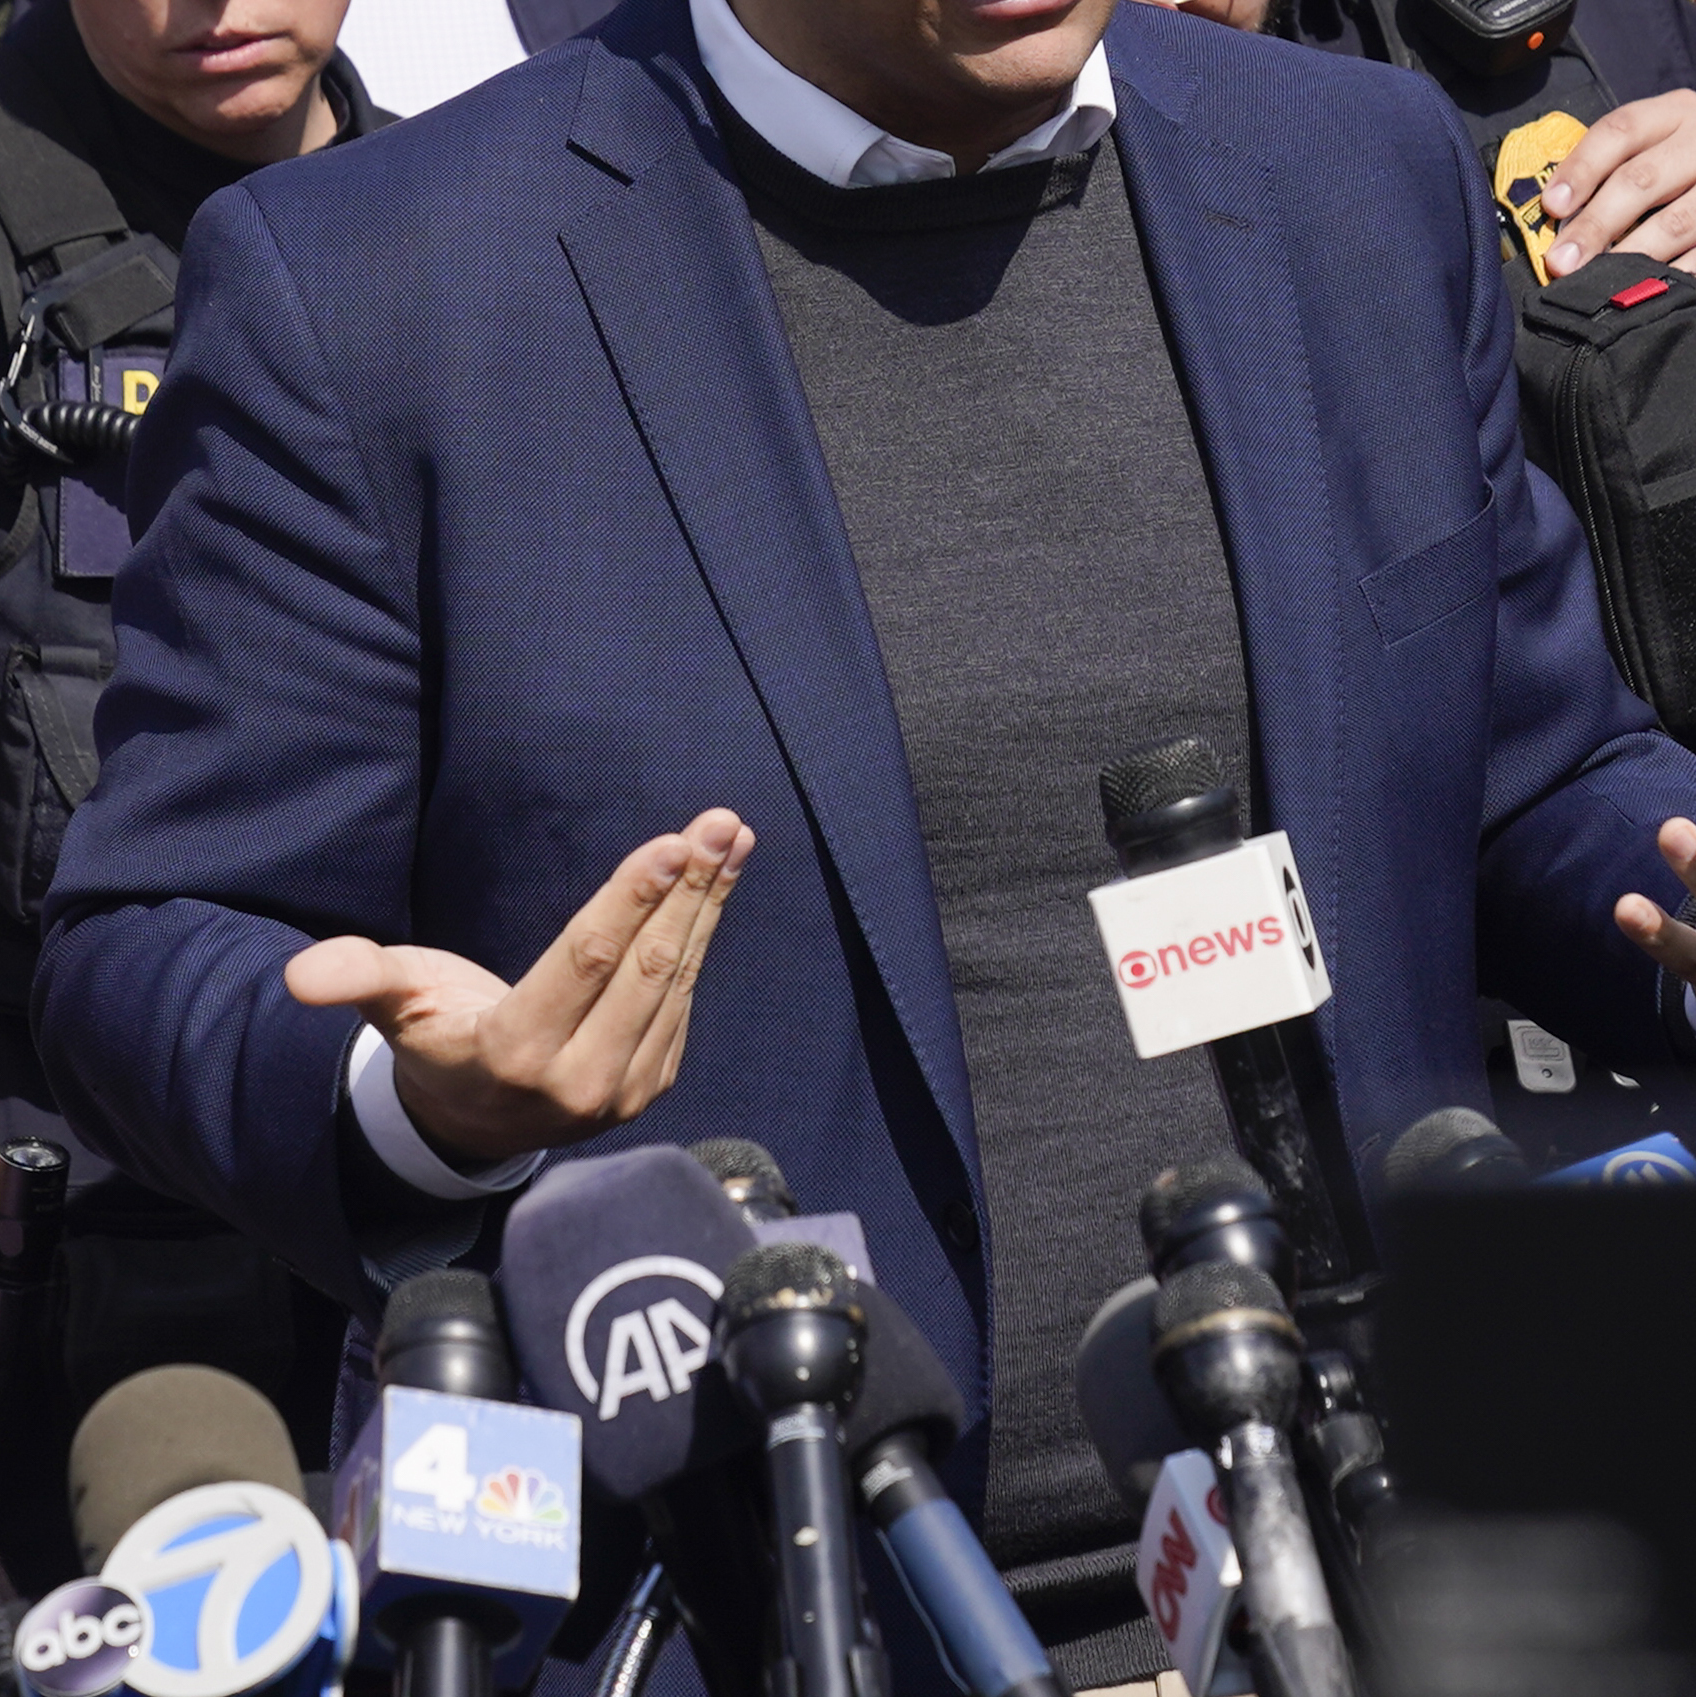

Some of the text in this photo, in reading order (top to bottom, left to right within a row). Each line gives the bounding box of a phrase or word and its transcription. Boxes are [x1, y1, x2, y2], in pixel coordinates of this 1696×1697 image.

[391, 1422, 477, 1513] 4
[390, 1503, 568, 1553] NEW YORK
[1151, 1506, 1199, 1644] CNN
[20, 1603, 143, 1673] abc
